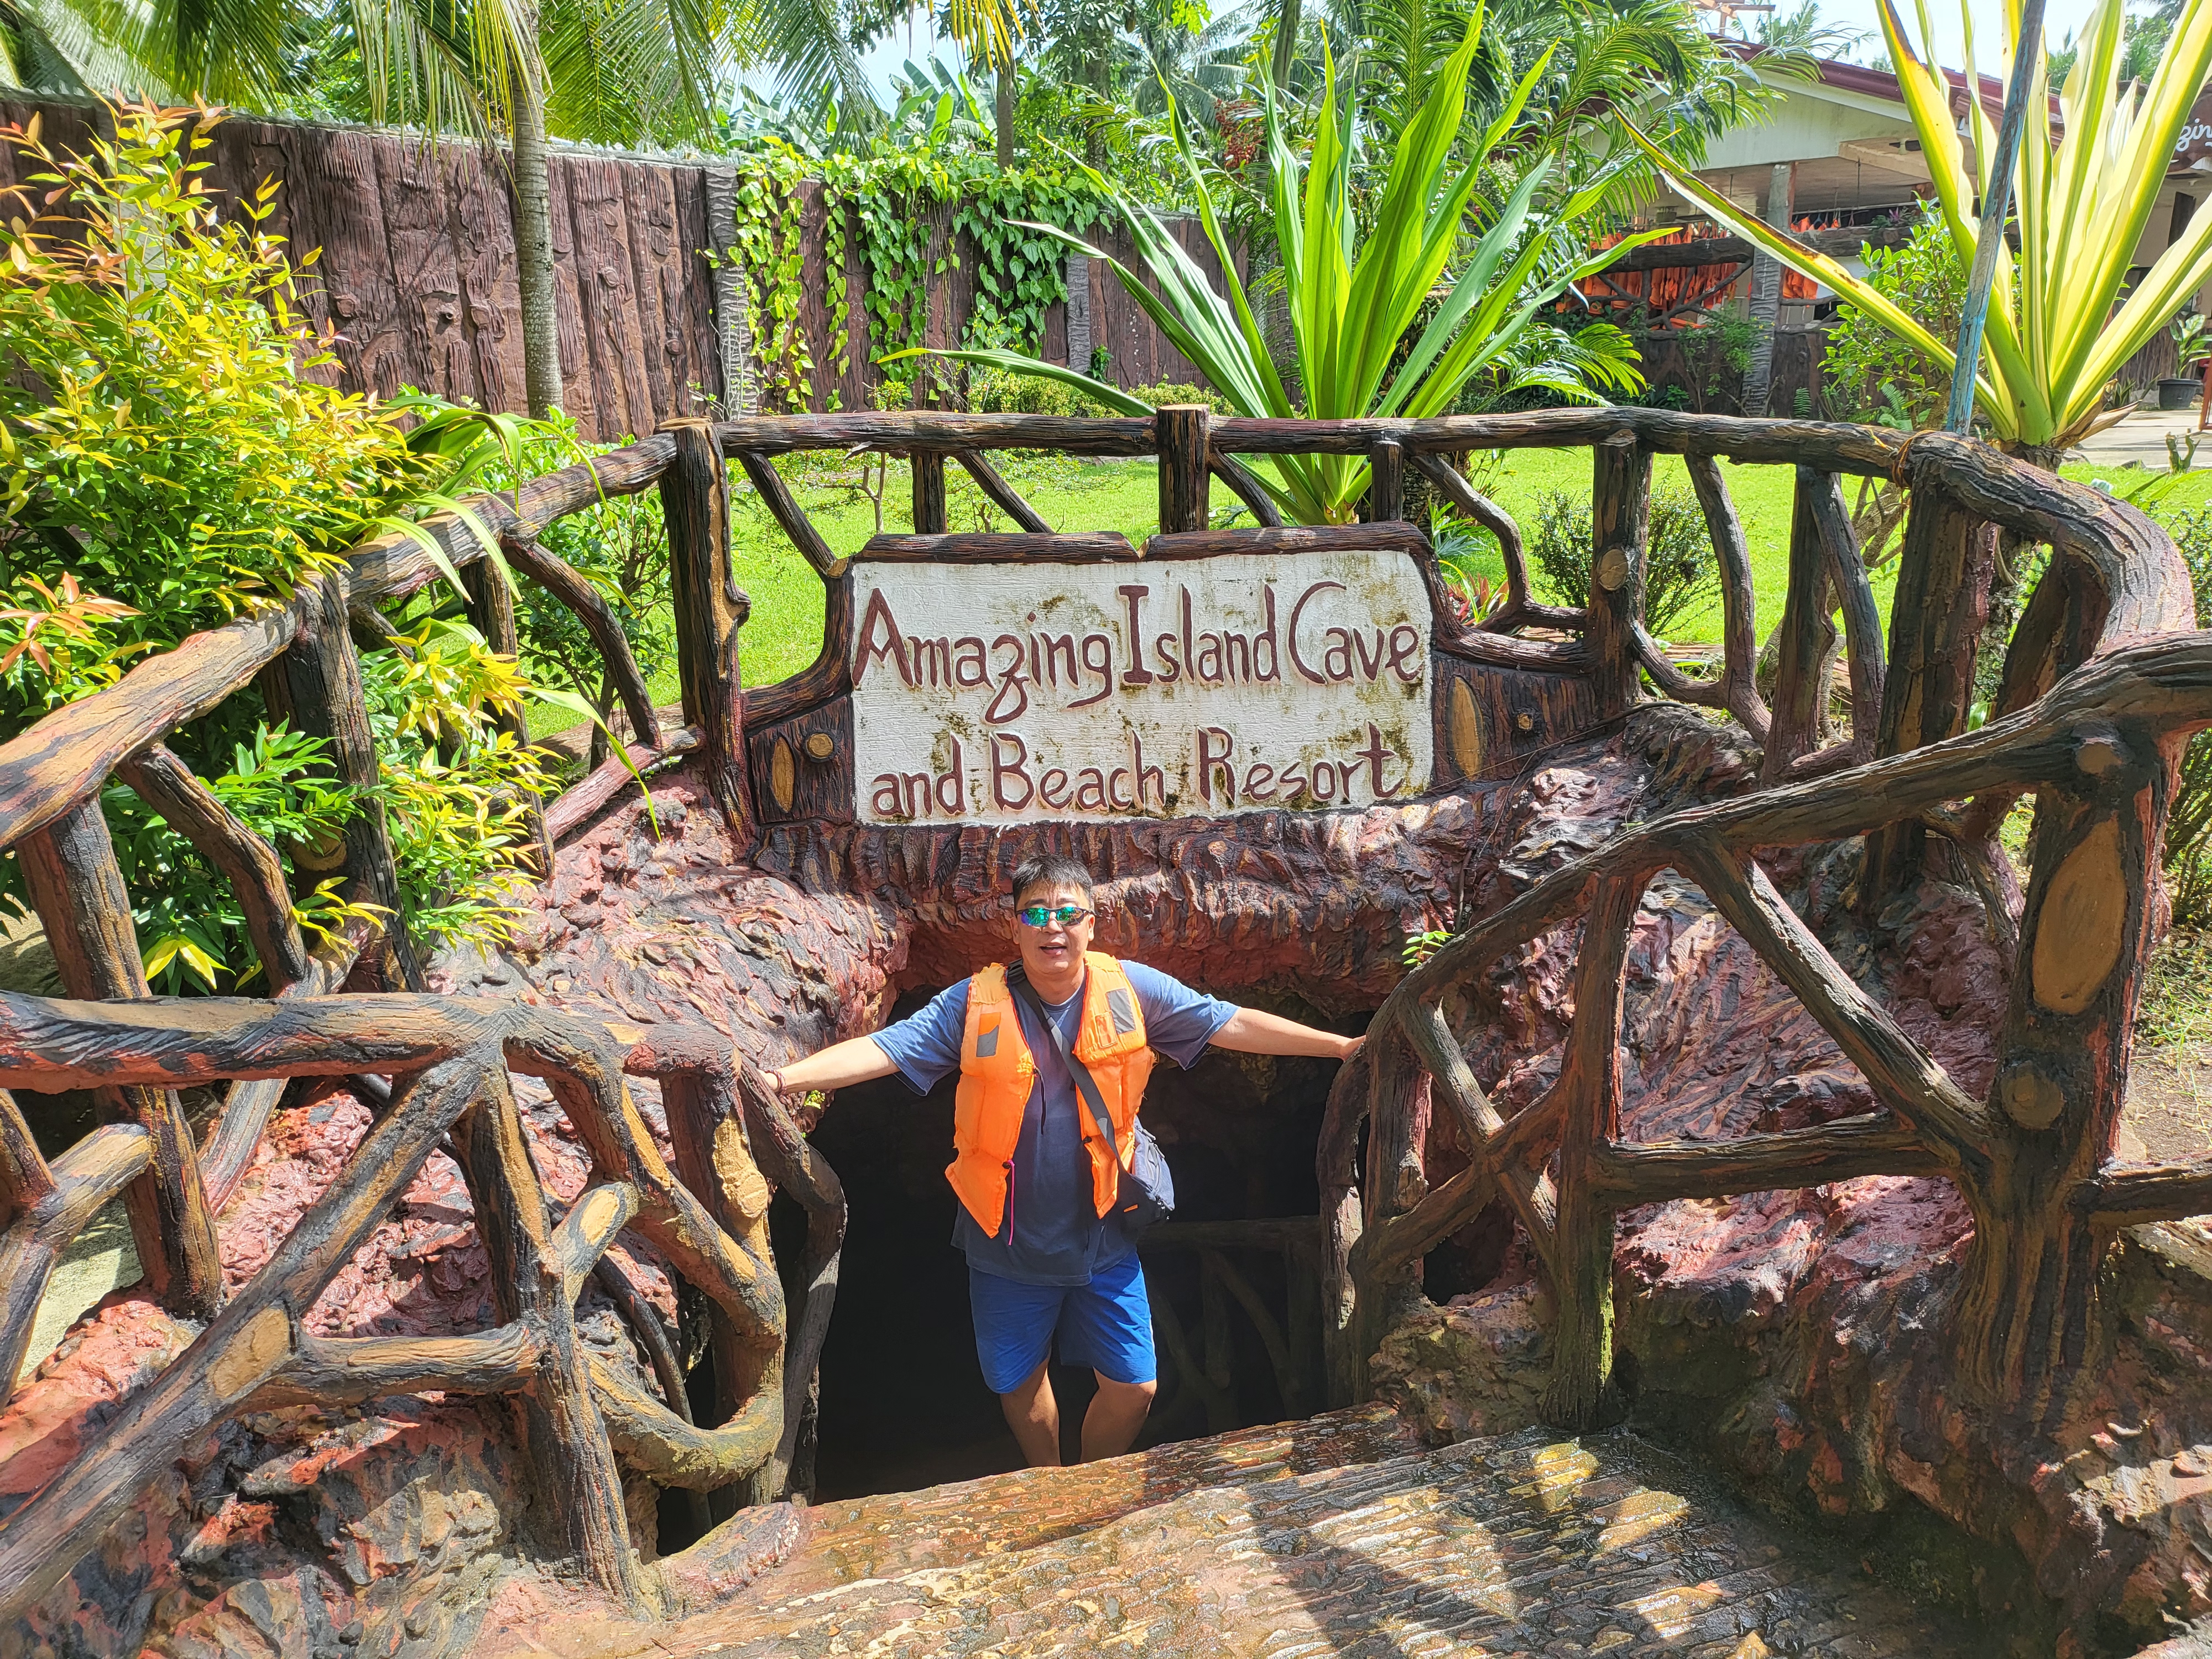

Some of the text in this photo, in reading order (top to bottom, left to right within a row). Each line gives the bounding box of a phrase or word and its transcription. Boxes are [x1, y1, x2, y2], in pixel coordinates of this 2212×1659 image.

[852, 581, 1423, 725] Amazing Island Cave
[872, 723, 1402, 818] and Beach Resort
